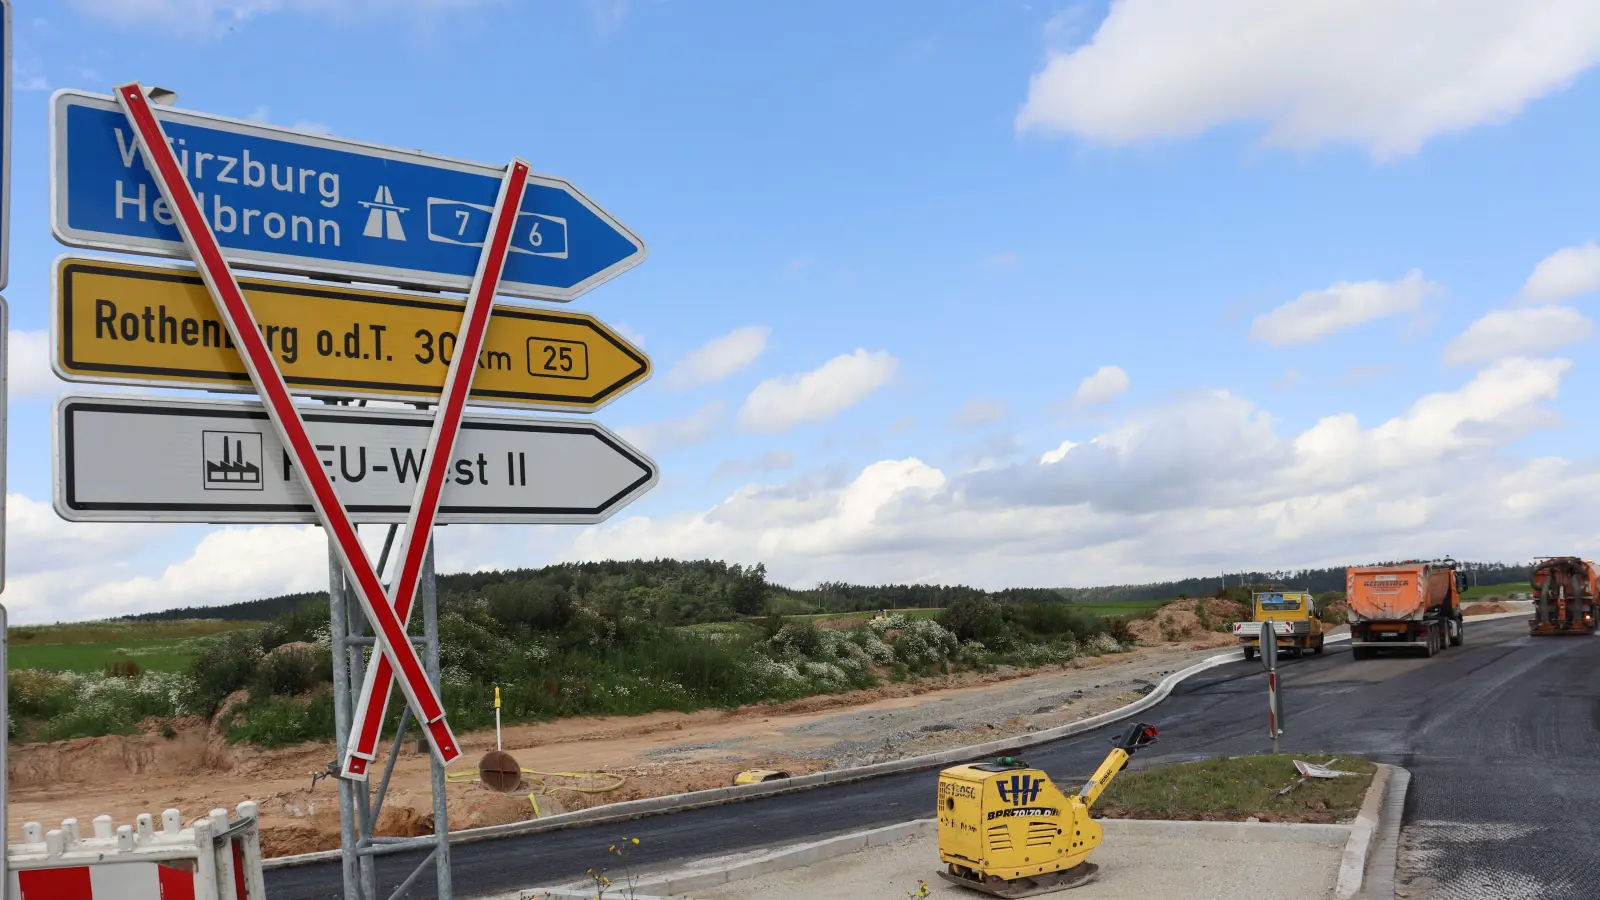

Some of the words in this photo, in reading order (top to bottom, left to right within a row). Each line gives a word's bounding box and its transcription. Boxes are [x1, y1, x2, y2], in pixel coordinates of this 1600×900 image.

[115, 180, 341, 247] Hebronn
[455, 210, 470, 236] 7
[528, 222, 543, 247] 6
[95, 298, 298, 364] Rothenrg
[316, 323, 393, 361] o.d.T.
[414, 328, 458, 367] 30
[542, 345, 573, 372] 25
[283, 444, 488, 486] U-Wst
